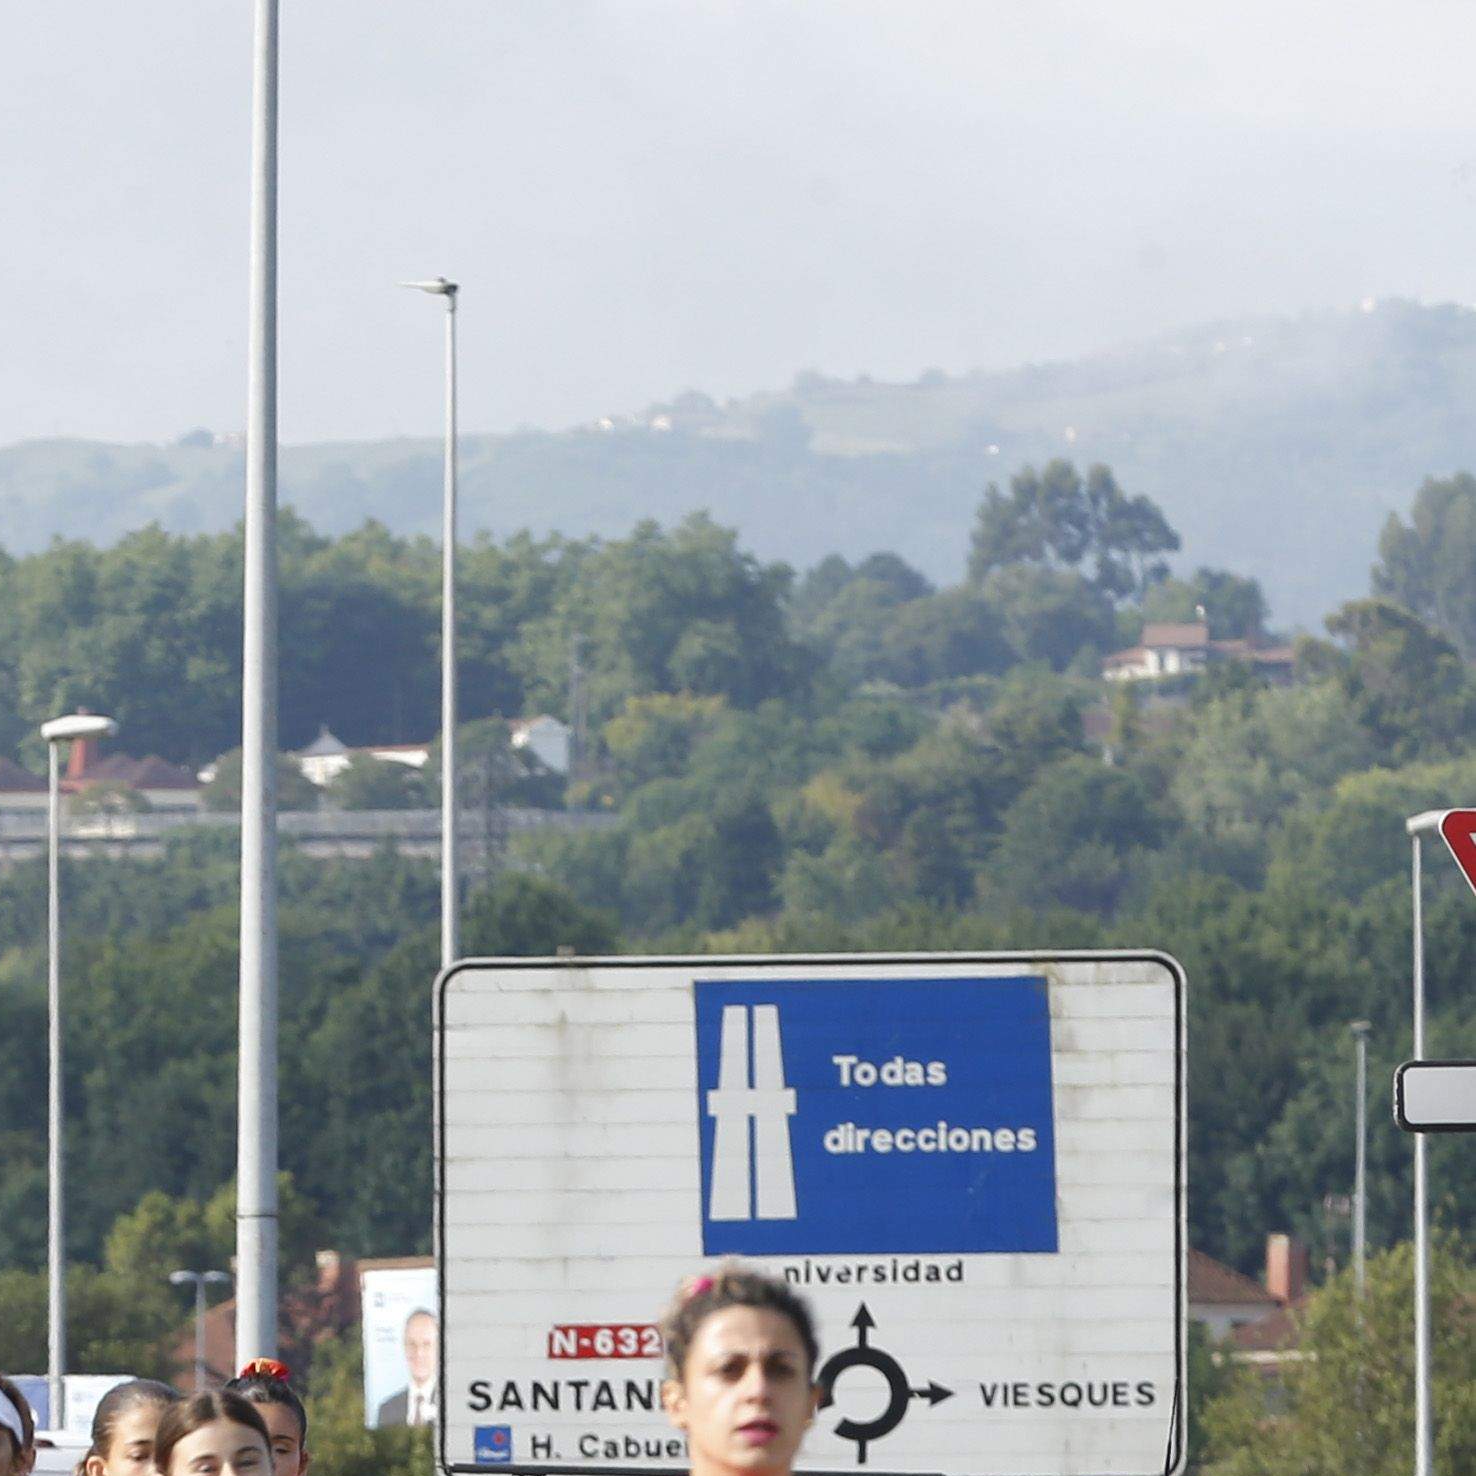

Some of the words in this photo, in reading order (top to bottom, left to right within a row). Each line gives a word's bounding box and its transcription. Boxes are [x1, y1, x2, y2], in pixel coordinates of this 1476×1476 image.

[832, 1054, 948, 1087] Todas
[823, 1121, 1038, 1155] direcciones
[784, 1258, 964, 1285] niversidad
[550, 1327, 663, 1357] N-632
[979, 1381, 1157, 1408] VIESQUES
[530, 1434, 561, 1459] H.
